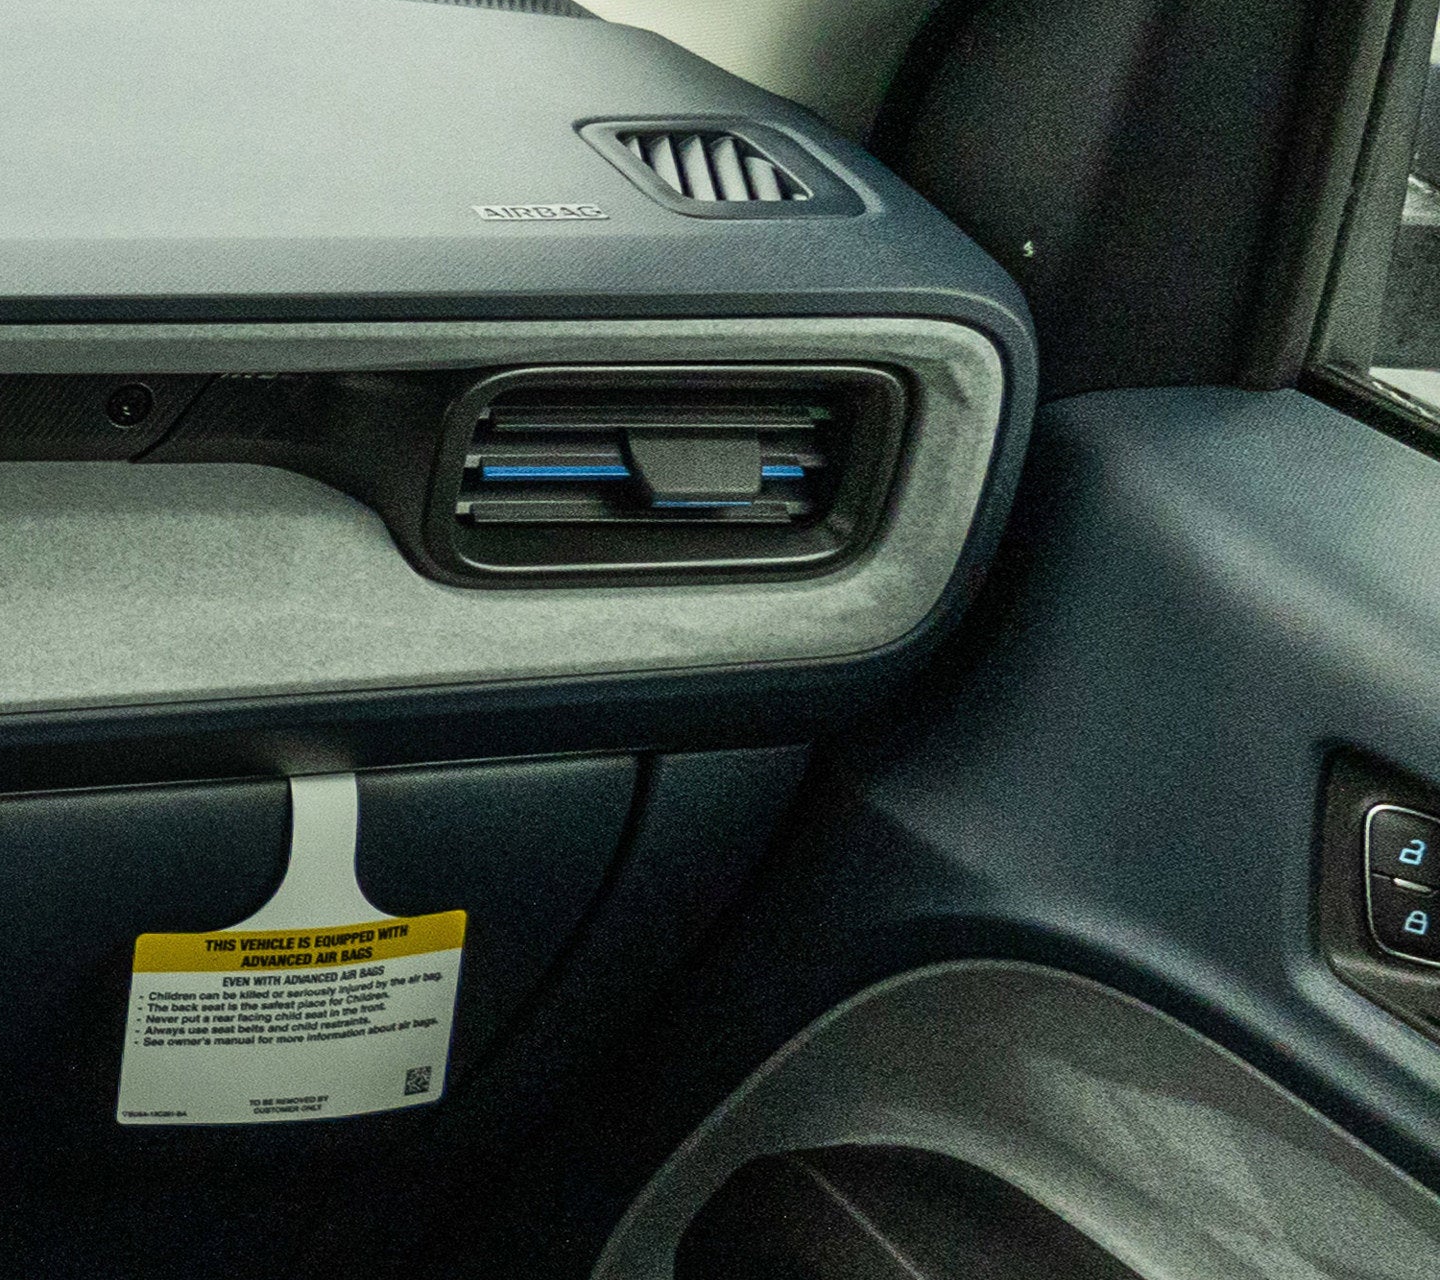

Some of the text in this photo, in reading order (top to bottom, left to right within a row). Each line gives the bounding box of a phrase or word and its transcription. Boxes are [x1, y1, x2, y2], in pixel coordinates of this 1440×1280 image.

[483, 206, 602, 218] AIRBAG
[205, 924, 409, 951] THIS VEHICLE IS EQUIPPED WITH
[241, 947, 373, 968] ADVANCED AIR BAGS
[222, 965, 385, 987] EVEN WITH ADVANCED AIR BAGS
[148, 991, 196, 1001] Children
[199, 992, 220, 1001] can
[222, 990, 236, 1000] be
[239, 989, 269, 999] killed
[272, 991, 284, 999] or
[287, 985, 336, 999] seriously
[339, 981, 373, 994] injured
[375, 980, 388, 990] by
[391, 977, 406, 986] the
[408, 974, 421, 984] air
[147, 1003, 168, 1012] The
[171, 1002, 198, 1012] back
[201, 1002, 225, 1012] seat
[228, 1002, 238, 1011] is
[241, 1001, 259, 1011] the
[261, 1000, 295, 1010] safest
[297, 998, 326, 1010] place
[329, 997, 343, 1006] for
[145, 1014, 179, 1024] Never
[181, 1014, 201, 1025] put
[212, 1014, 236, 1022] rear
[238, 1012, 272, 1024] facing
[275, 1011, 302, 1021] child
[304, 1010, 328, 1020] seat
[331, 1008, 340, 1017] in
[342, 1007, 358, 1016] the
[143, 1037, 164, 1047] See
[167, 1036, 211, 1046] owner's
[214, 1035, 255, 1045] manual
[258, 1035, 273, 1044] for
[276, 1035, 305, 1044] more
[307, 1028, 366, 1041] information
[368, 1023, 396, 1034] about
[398, 1020, 411, 1030] air
[144, 1026, 185, 1036] Always
[188, 1026, 208, 1035] use
[211, 1025, 235, 1034] seat
[237, 1023, 265, 1033] belts
[267, 1022, 289, 1032] and
[291, 1021, 318, 1031] child
